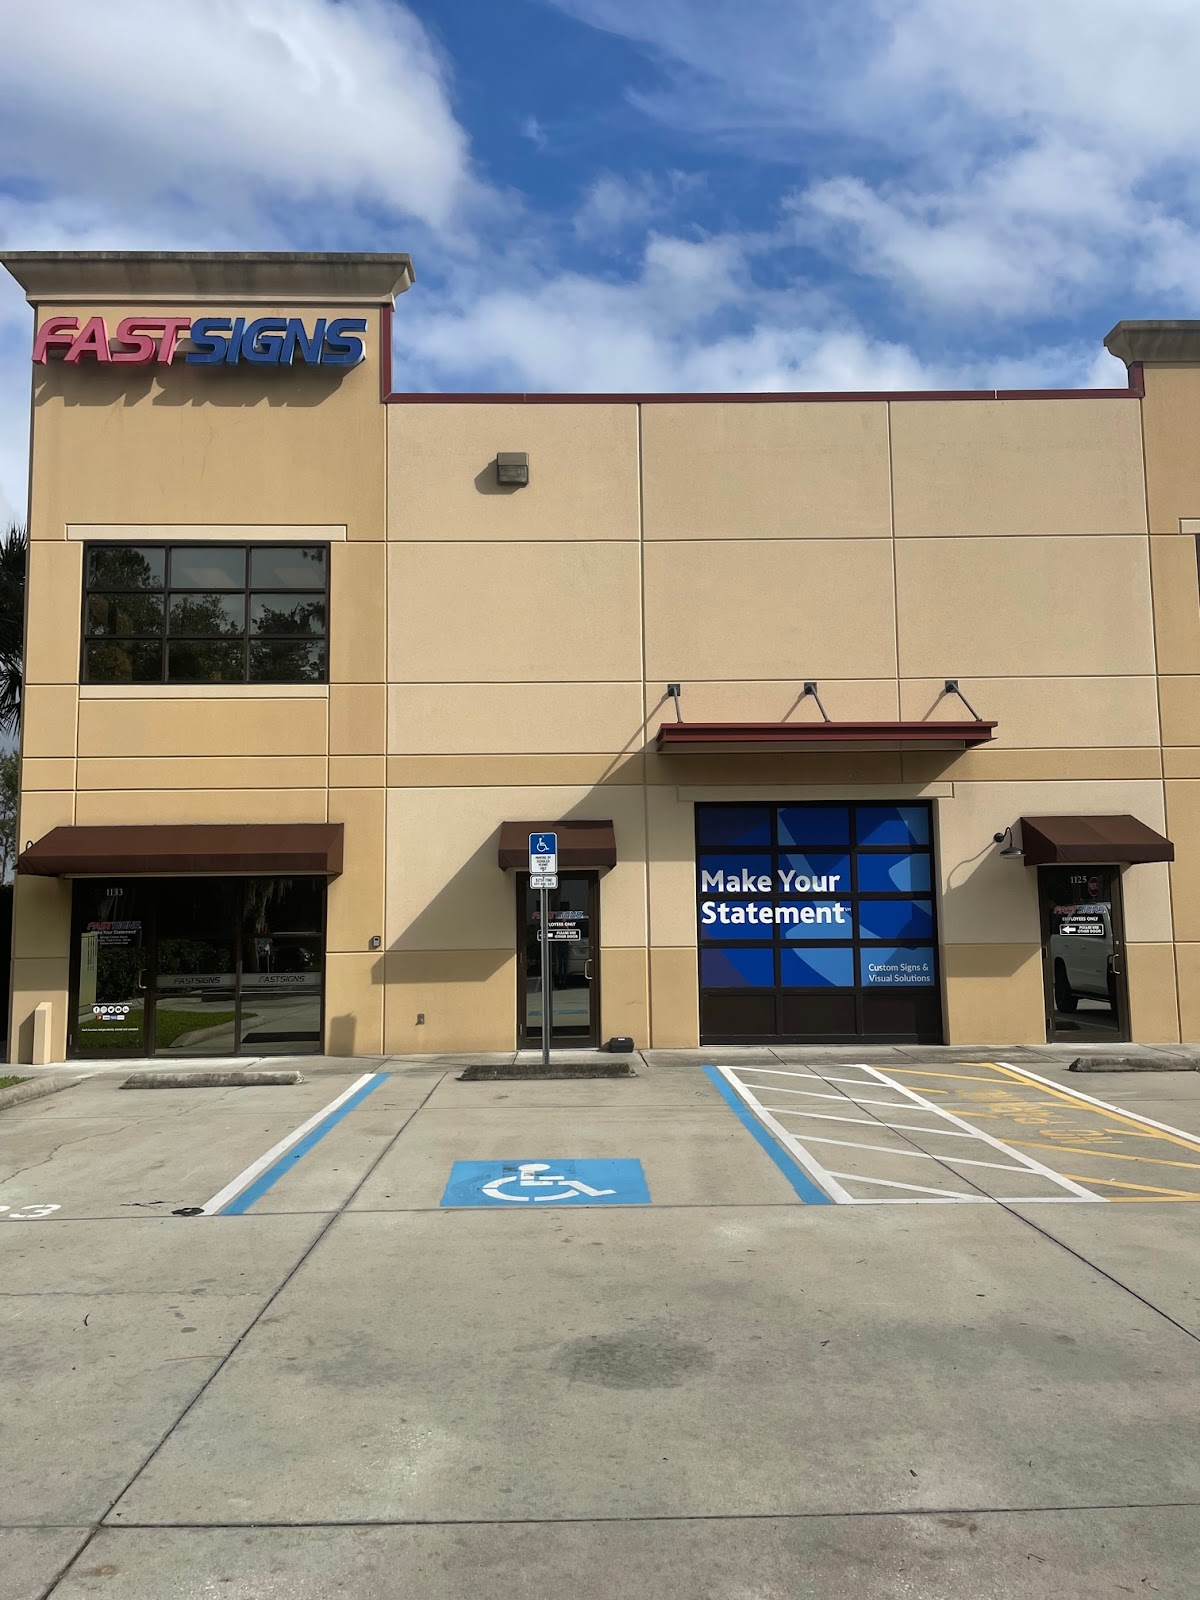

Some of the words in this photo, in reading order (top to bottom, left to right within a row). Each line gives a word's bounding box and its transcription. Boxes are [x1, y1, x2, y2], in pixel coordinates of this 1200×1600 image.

[32, 316, 367, 365] FASTSIGNS
[701, 868, 772, 892] Make
[777, 870, 841, 892] Your
[1071, 876, 1087, 884] 1125
[106, 888, 124, 896] 1133
[701, 901, 846, 924] Statement
[1053, 905, 1106, 914] FASTSIGNS
[87, 921, 142, 931] FASTSIGNS
[868, 963, 898, 971] Custom
[900, 963, 920, 972] Signs
[923, 963, 929, 971] &
[173, 976, 221, 984] FASTSIGNS
[259, 975, 305, 983] FASTSIGNS
[869, 974, 892, 982] Visual
[894, 974, 930, 982] Solutions
